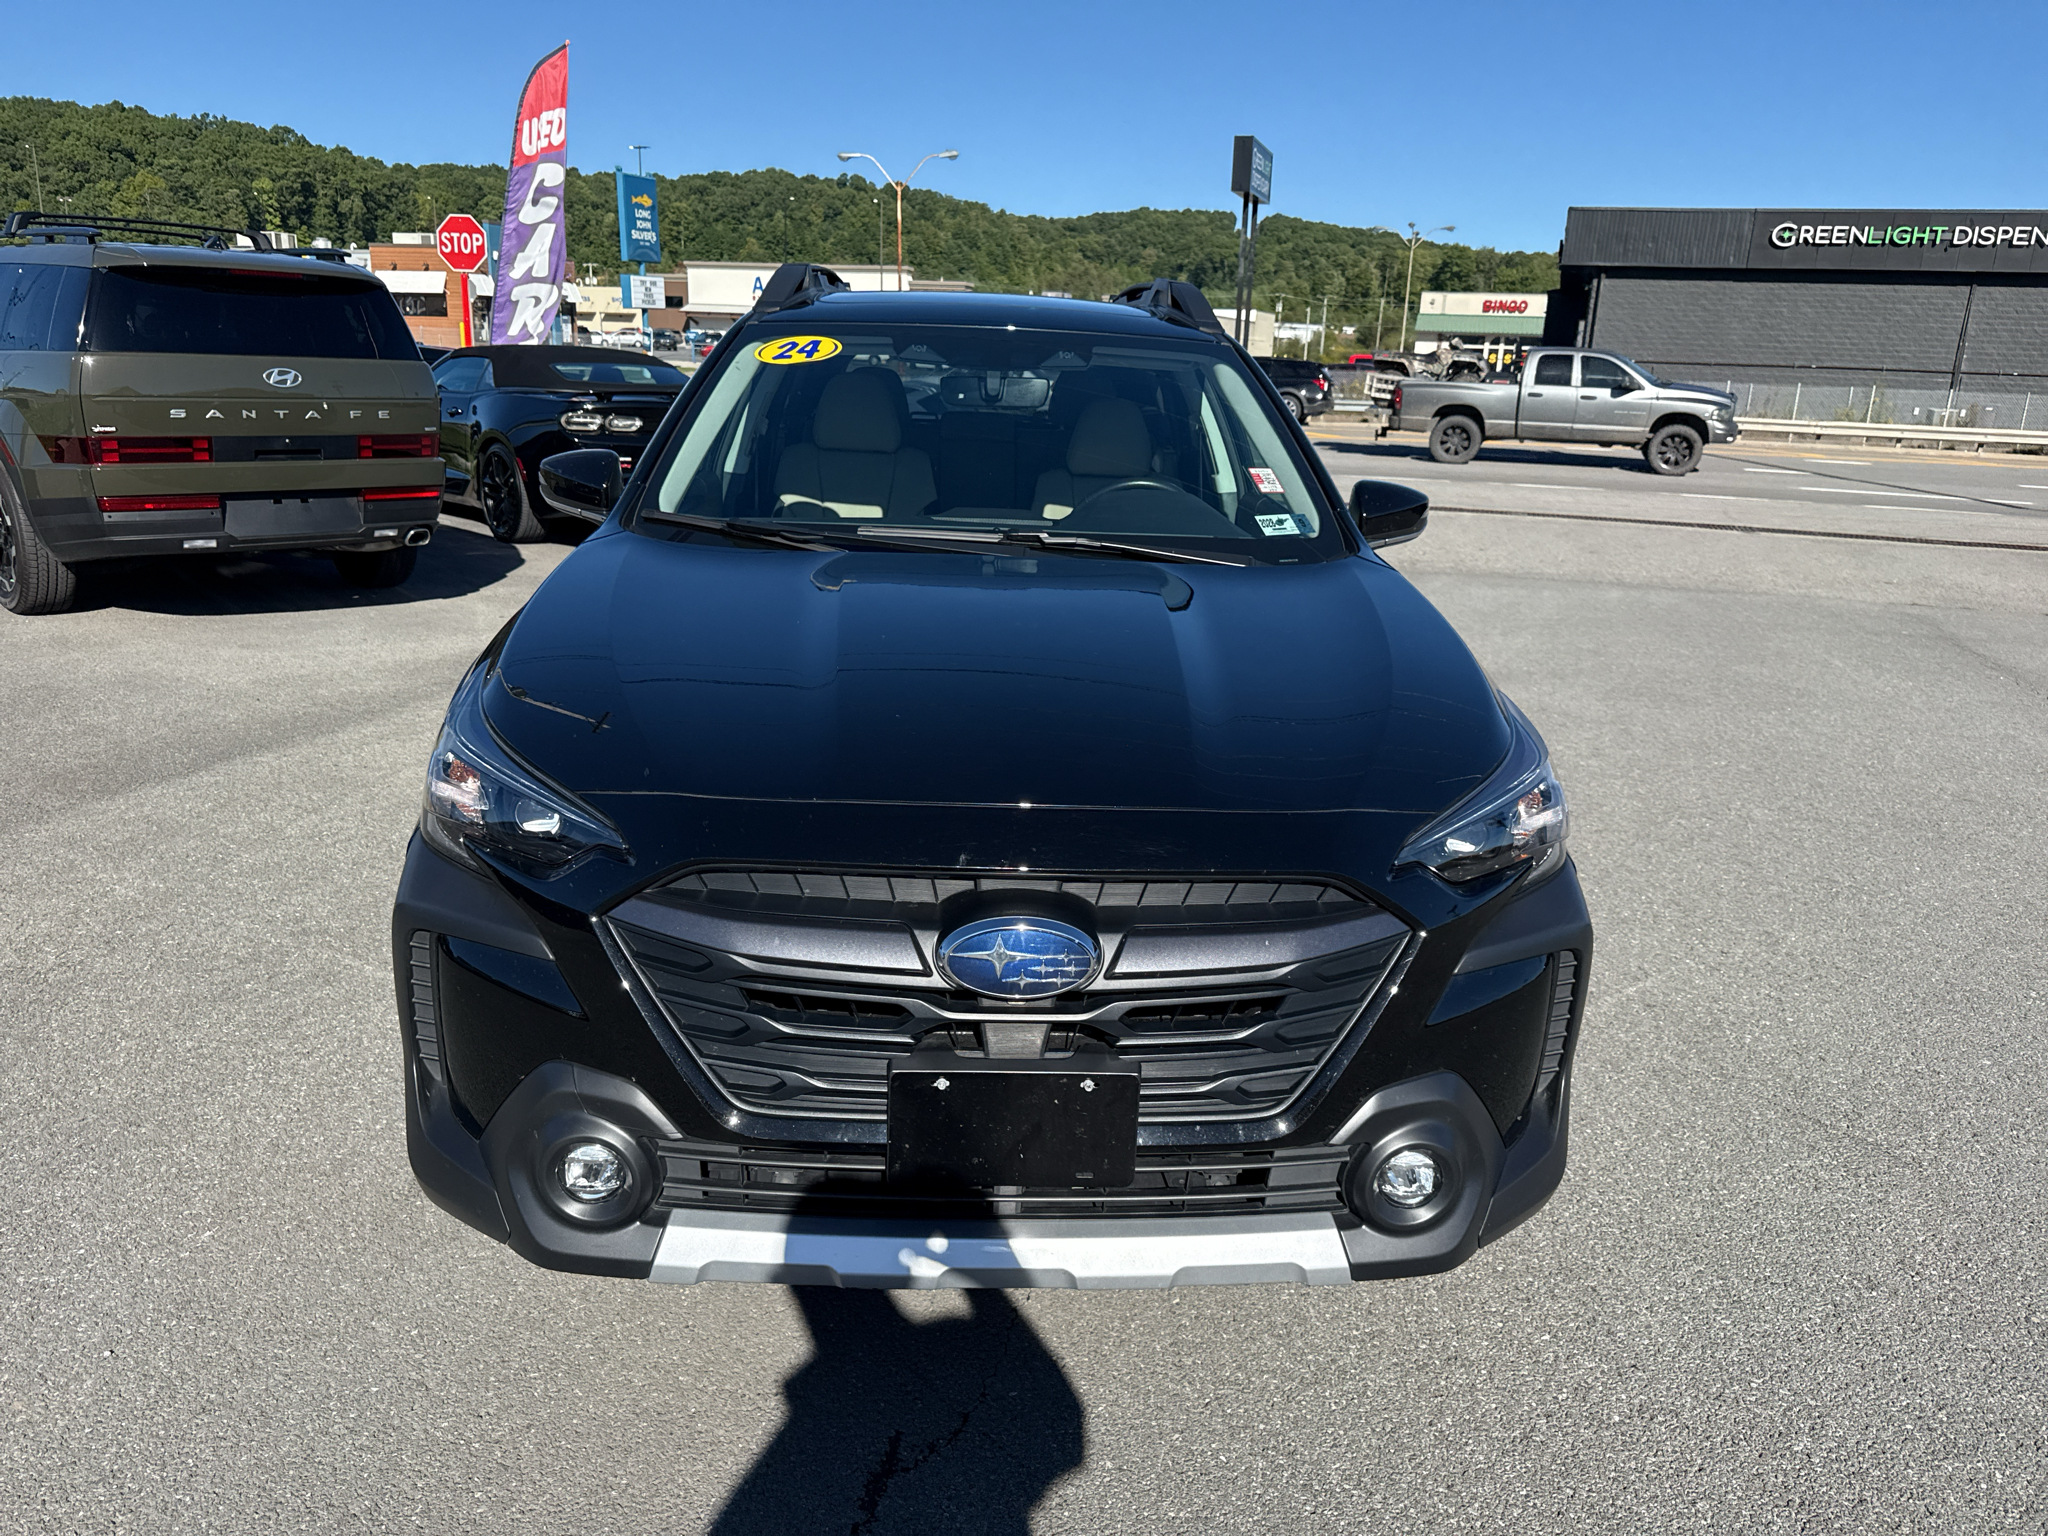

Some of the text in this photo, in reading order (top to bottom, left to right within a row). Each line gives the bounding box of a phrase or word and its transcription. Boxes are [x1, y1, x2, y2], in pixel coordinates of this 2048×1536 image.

[634, 208, 652, 220] LONG
[636, 219, 652, 230] JOHN
[631, 229, 657, 244] SILVER'S
[1771, 223, 1949, 247] GREENLIGHT
[440, 232, 484, 255] STOP
[1482, 300, 1528, 314] BINGO
[771, 340, 823, 361] 24
[169, 408, 391, 420] SANTA FE
